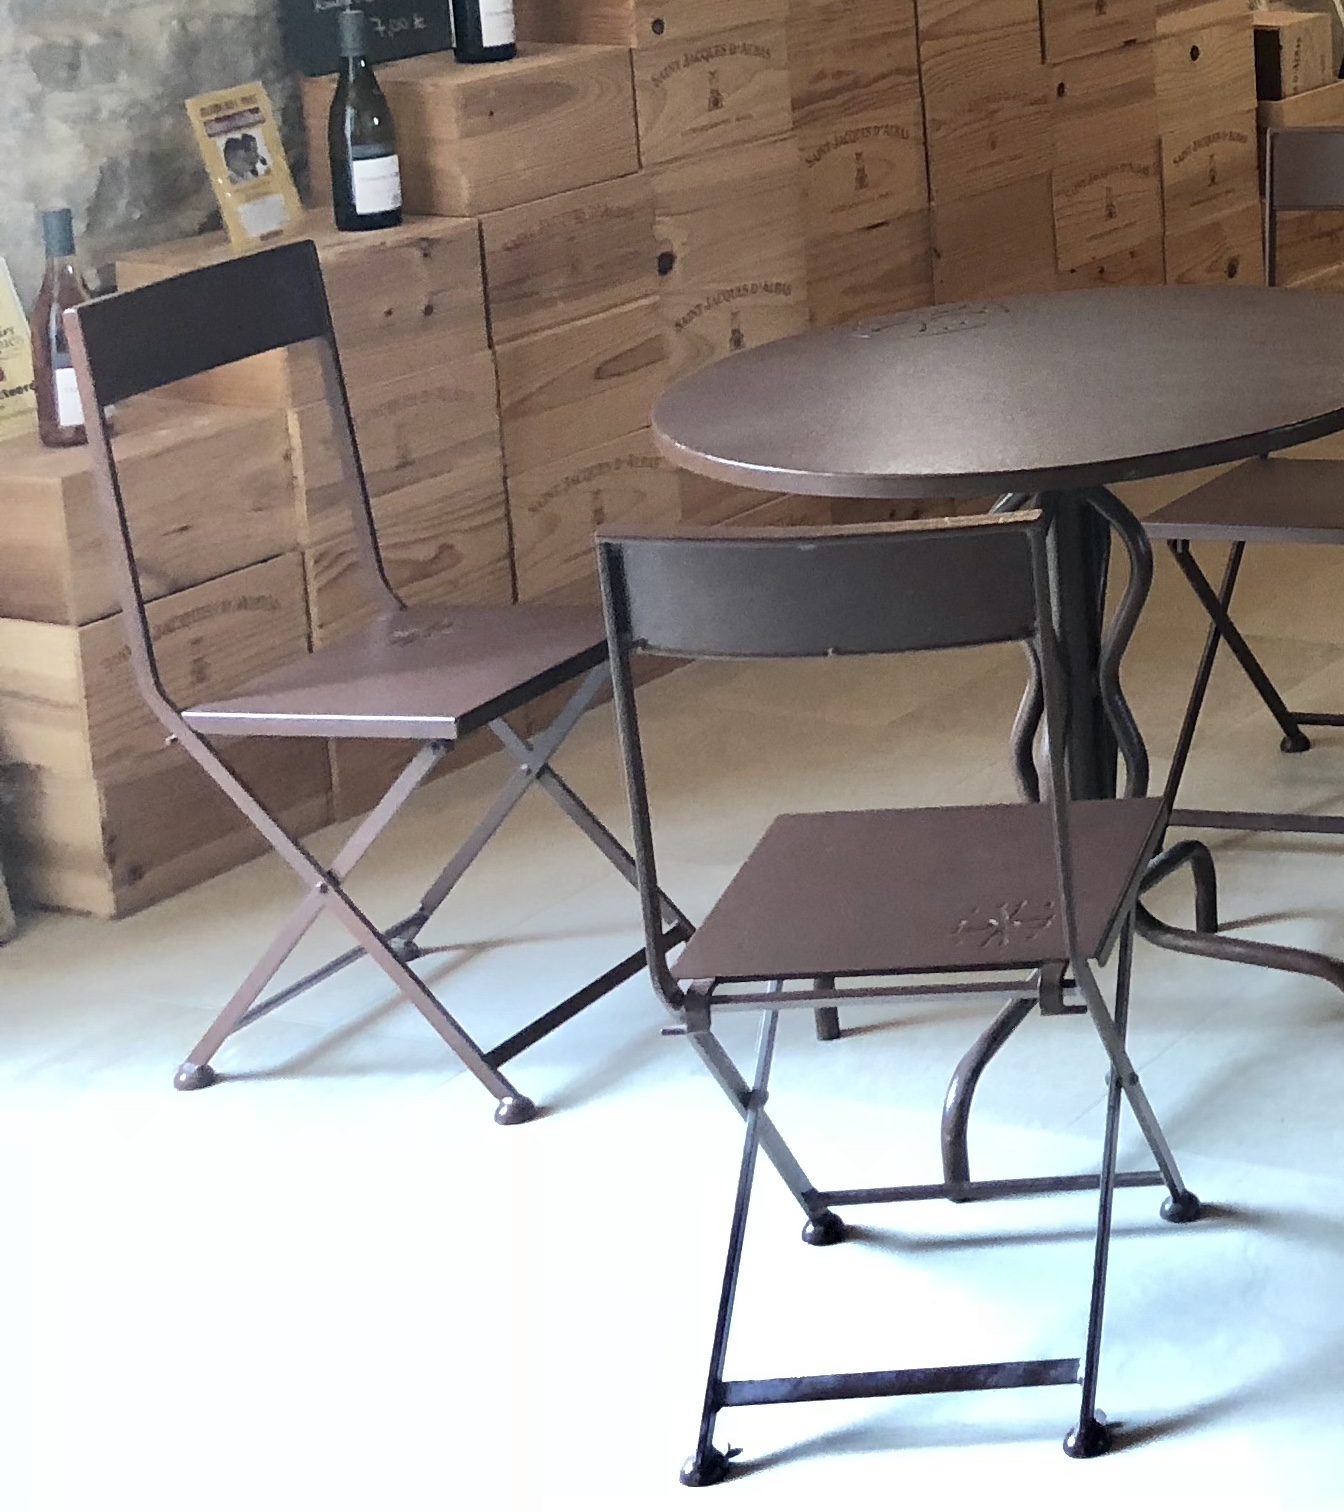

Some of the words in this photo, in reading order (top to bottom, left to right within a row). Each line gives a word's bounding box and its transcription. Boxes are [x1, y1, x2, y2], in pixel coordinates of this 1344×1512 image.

[651, 60, 680, 88] SAINT
[683, 45, 727, 68] JACQUES
[704, 284, 749, 310] JACQUES
